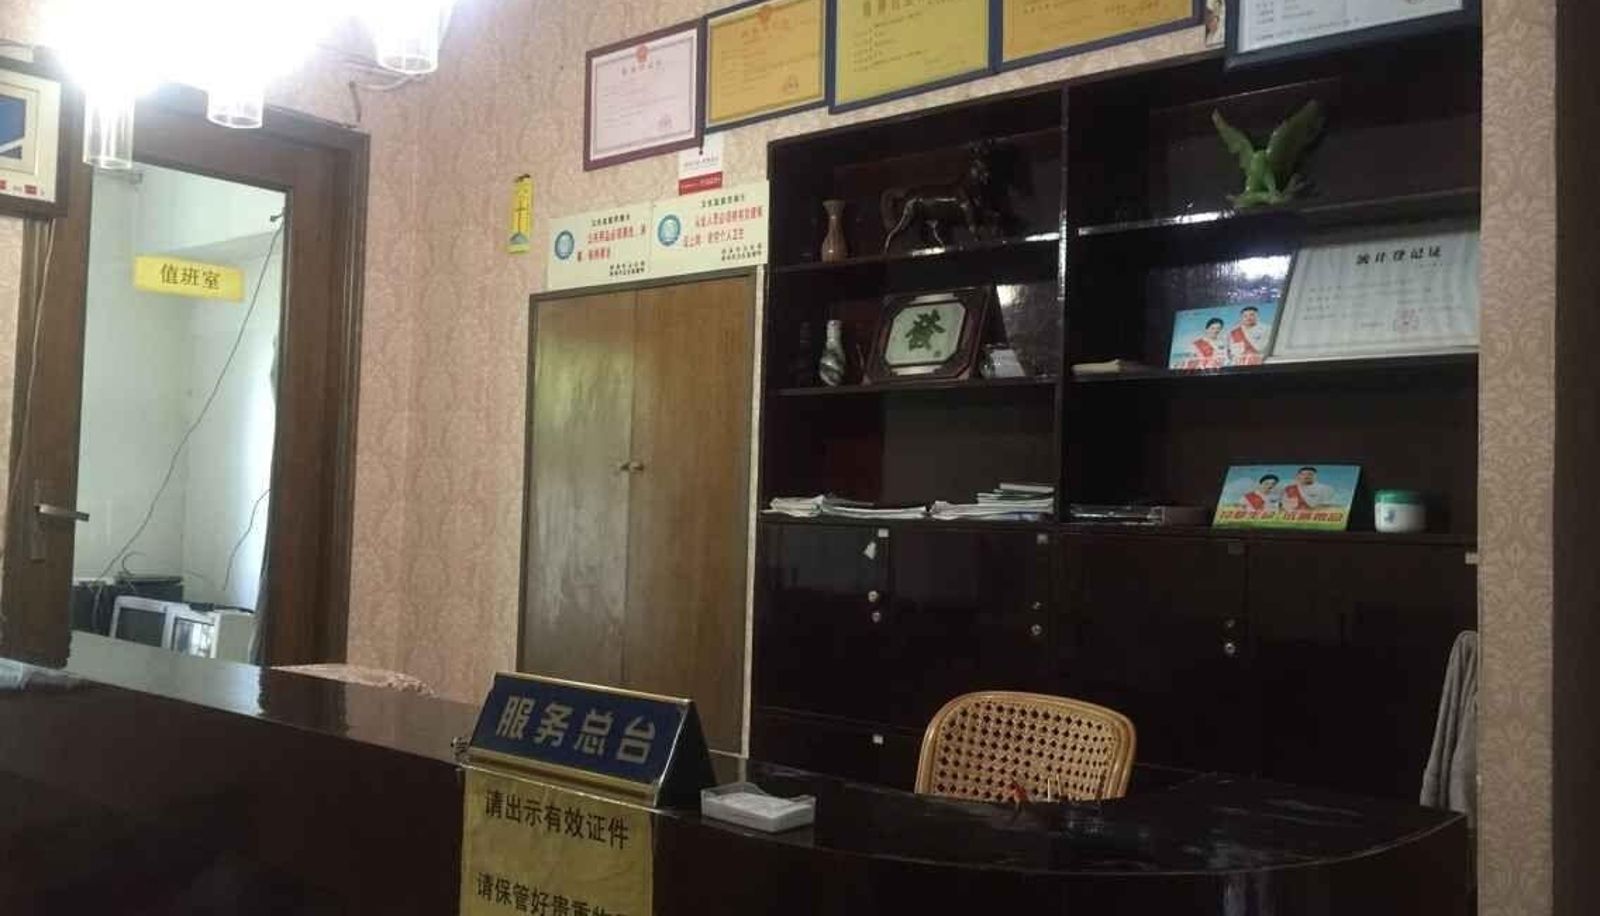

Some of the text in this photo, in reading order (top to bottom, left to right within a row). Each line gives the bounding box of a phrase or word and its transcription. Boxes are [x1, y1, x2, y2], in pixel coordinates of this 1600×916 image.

[159, 263, 221, 291] 值班室
[495, 697, 656, 764] 服务总台
[484, 788, 629, 850] 请出示有效证件
